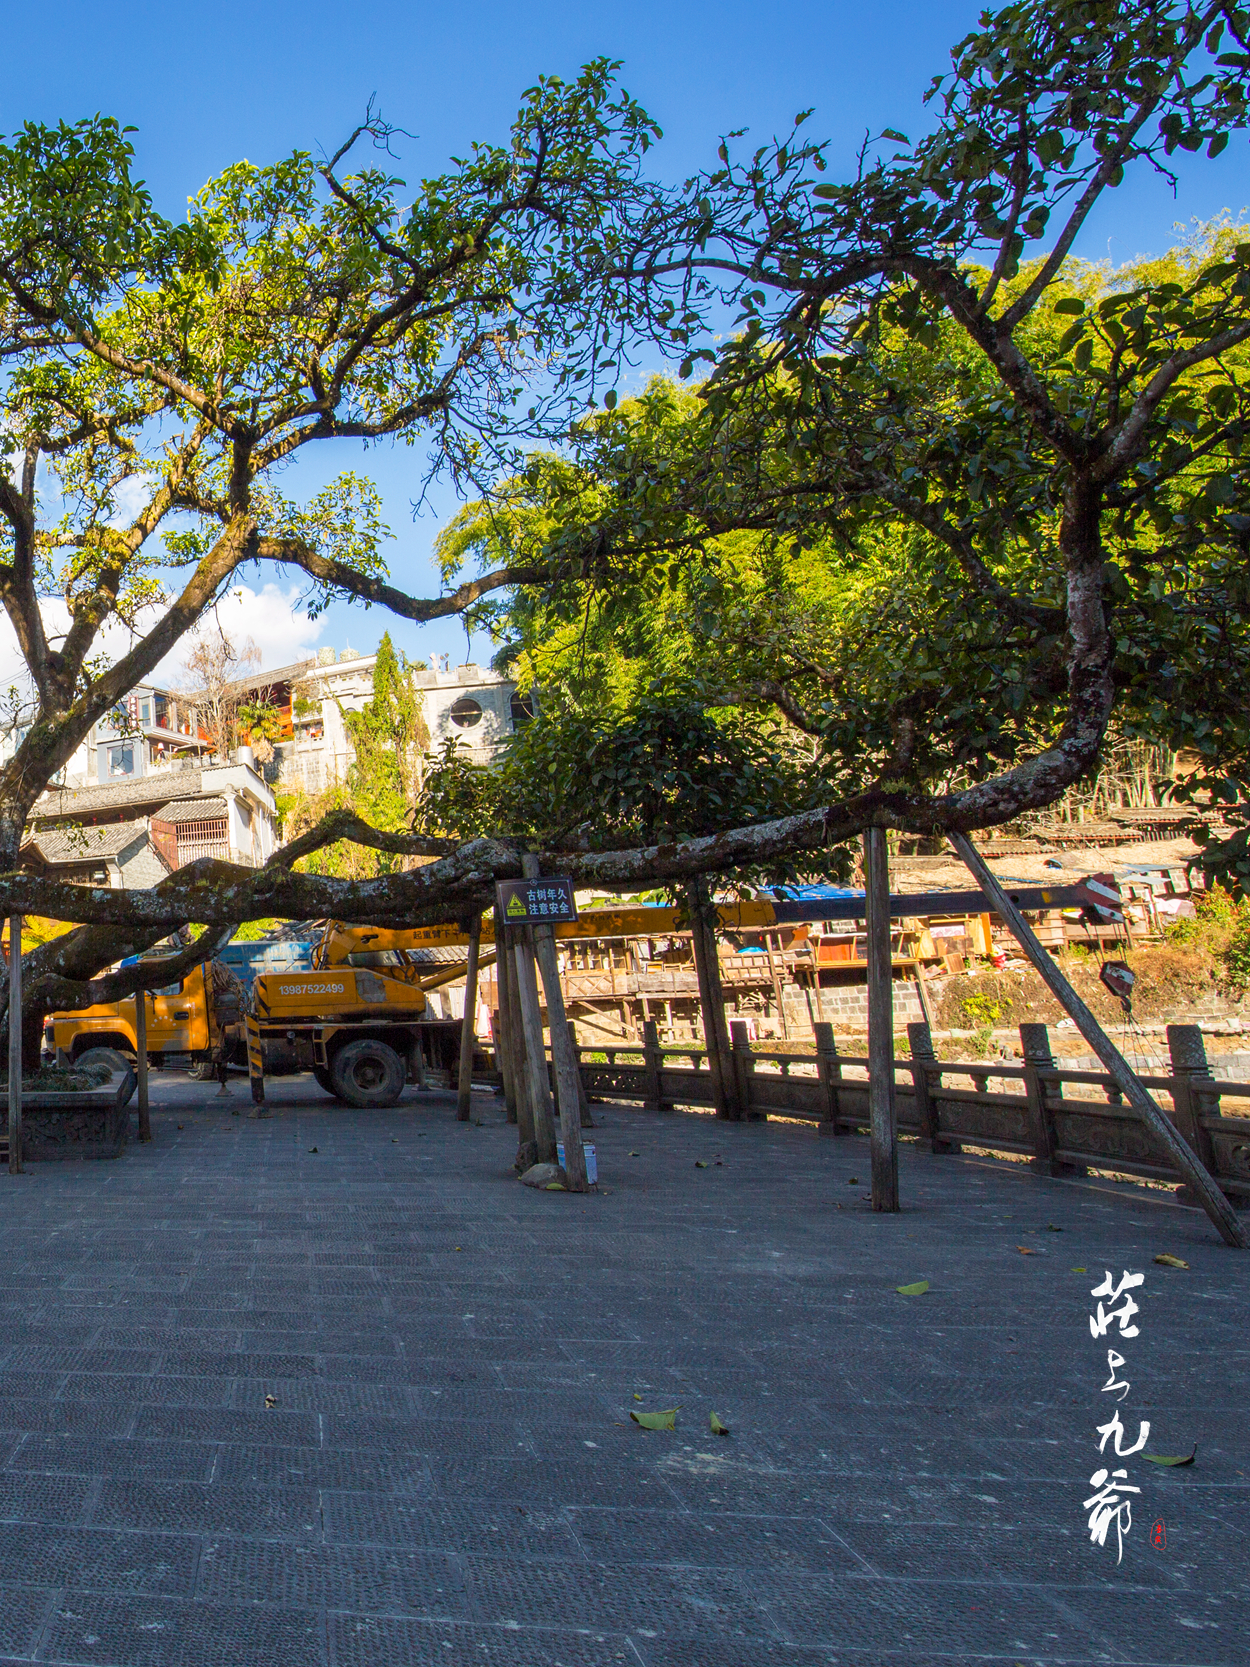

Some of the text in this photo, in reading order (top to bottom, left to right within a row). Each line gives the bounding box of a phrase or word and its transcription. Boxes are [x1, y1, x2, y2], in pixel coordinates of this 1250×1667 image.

[526, 888, 567, 901] 古树年久
[528, 902, 569, 915] 注意安全
[278, 983, 344, 995] 13987522499
